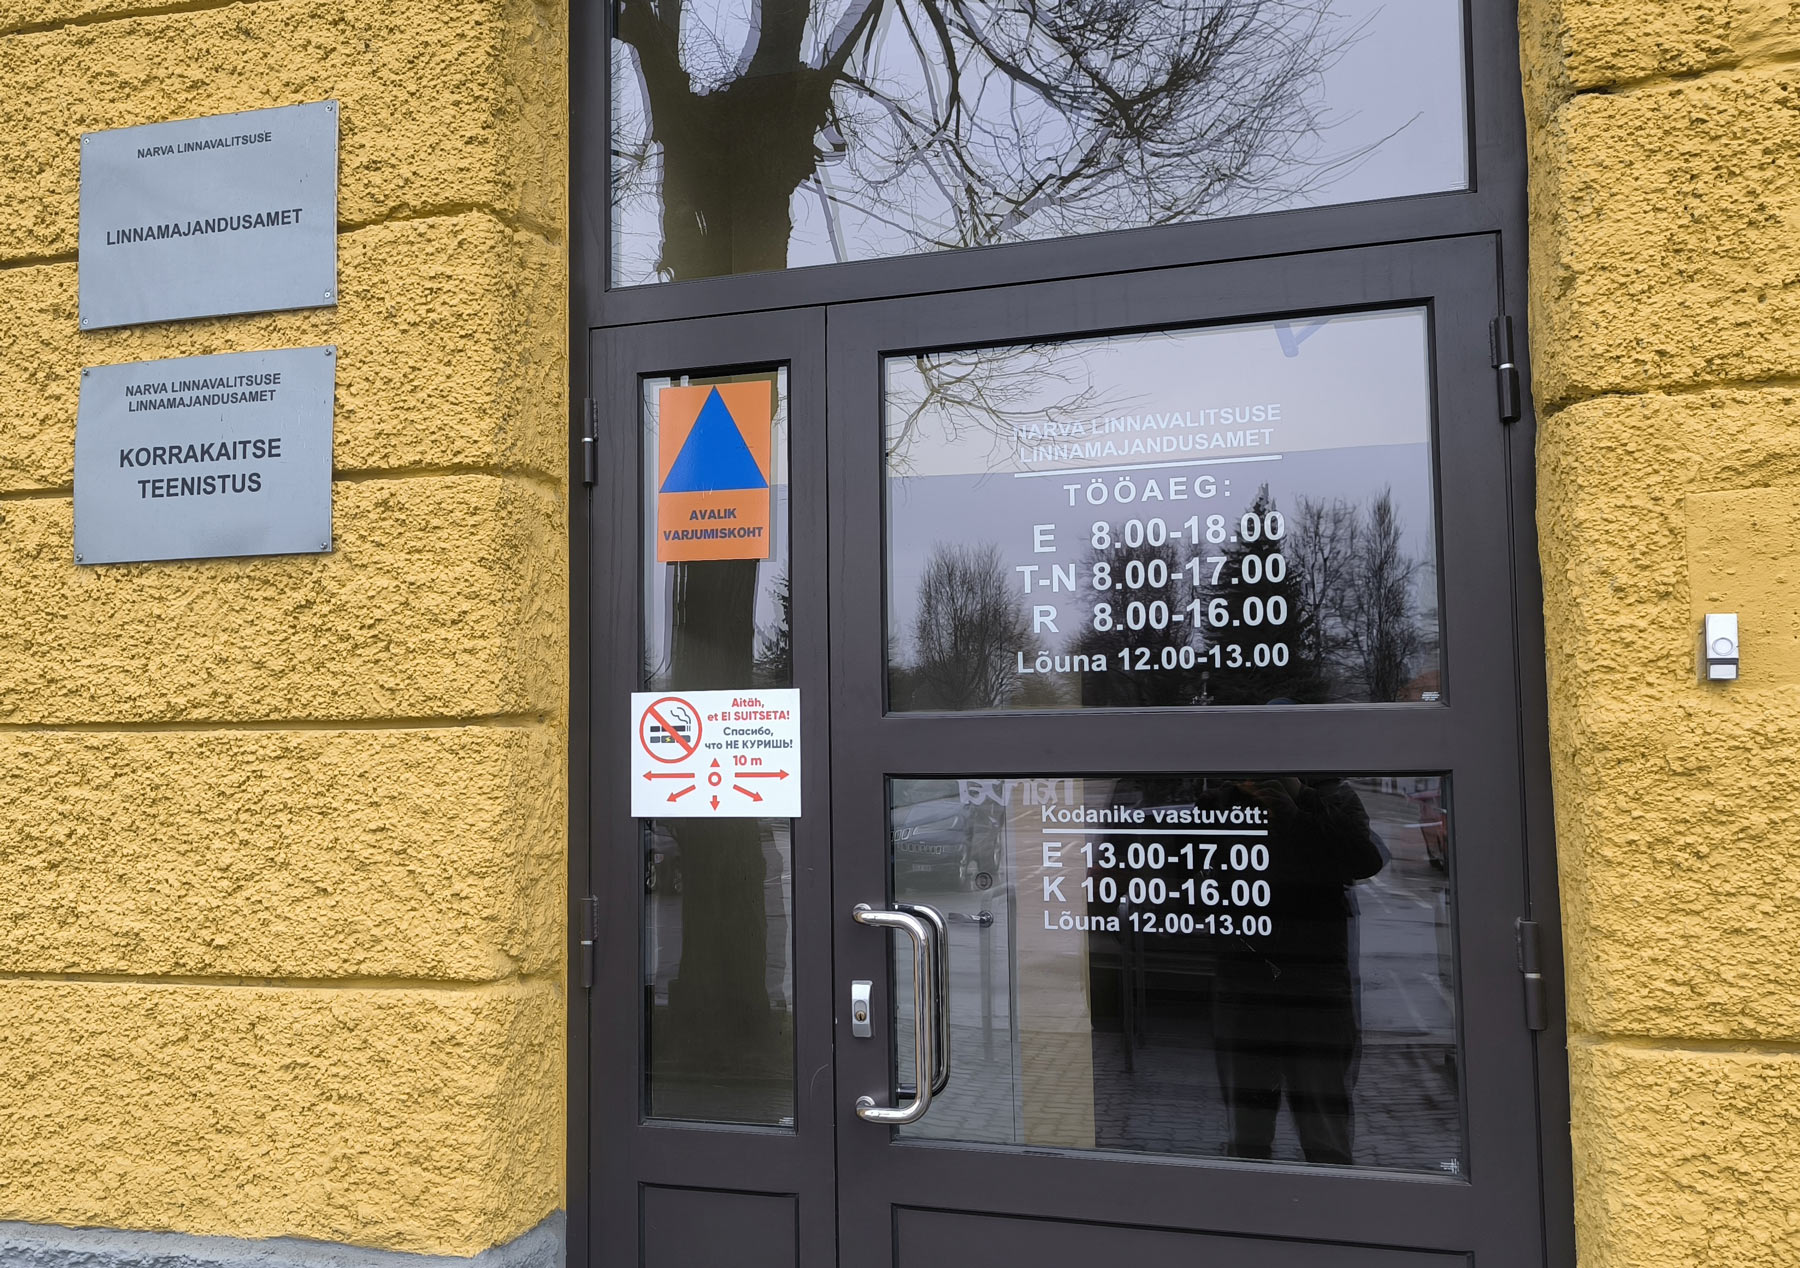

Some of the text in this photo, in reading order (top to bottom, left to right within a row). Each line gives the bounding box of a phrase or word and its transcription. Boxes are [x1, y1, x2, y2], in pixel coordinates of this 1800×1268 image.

[137, 131, 272, 159] NARVA LINNAVALITSUSE
[106, 208, 303, 246] LINNAMAJANDUSAMET
[125, 372, 281, 397] NARVA LINNAVALITSUSE
[128, 389, 276, 412] LINNAMAJANDUSAMET
[1013, 403, 1282, 440] NARVA LINNAVALITSUSE
[119, 437, 282, 468] KORRAKAITSE
[1019, 428, 1274, 463] LINNAMAJANDUSAMET
[137, 472, 262, 499] TEENISTUS
[1063, 475, 1231, 507] TÖÖAEG:
[689, 508, 737, 521] AVALIK
[663, 526, 764, 541] VARJUMISKOHT
[1033, 511, 1285, 553] E 8.00-18.00
[1016, 553, 1287, 594] T-N 8.00-17.00
[1033, 595, 1288, 634] R 8.00-16.00
[1017, 643, 1290, 674] Lõuna 12.00-13.00
[707, 710, 790, 721] et EI SUITSETA!
[731, 698, 765, 708] Aitäh,
[705, 739, 793, 750] что НЕ КУРИШЬ!
[723, 726, 774, 737] Спасибо,
[733, 755, 762, 766] 10 m
[1041, 804, 1269, 825] Kodanike vastuvõtt:
[1042, 842, 1270, 871] E 13.00-17.00
[1043, 876, 1271, 907] K 10.00-16.00
[1044, 910, 1273, 936] Lõuna 12.00-13.00
